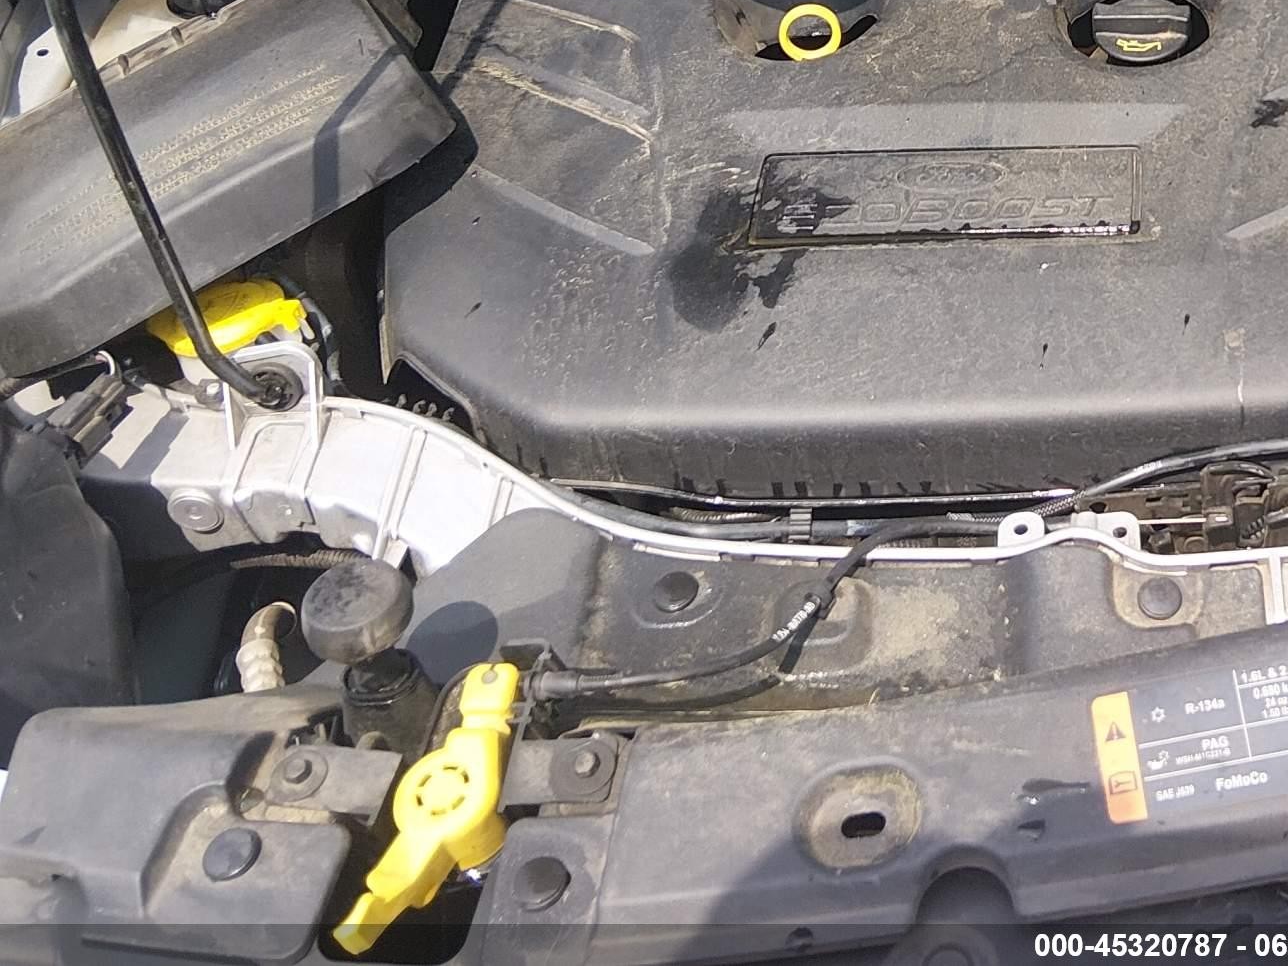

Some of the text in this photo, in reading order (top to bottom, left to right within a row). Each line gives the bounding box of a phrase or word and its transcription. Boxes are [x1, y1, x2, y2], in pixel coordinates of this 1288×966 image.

[1185, 698, 1226, 715] R-134a
[1201, 736, 1230, 751] PAG
[1215, 771, 1269, 791] FoMoCo
[1155, 787, 1175, 802] SAE
